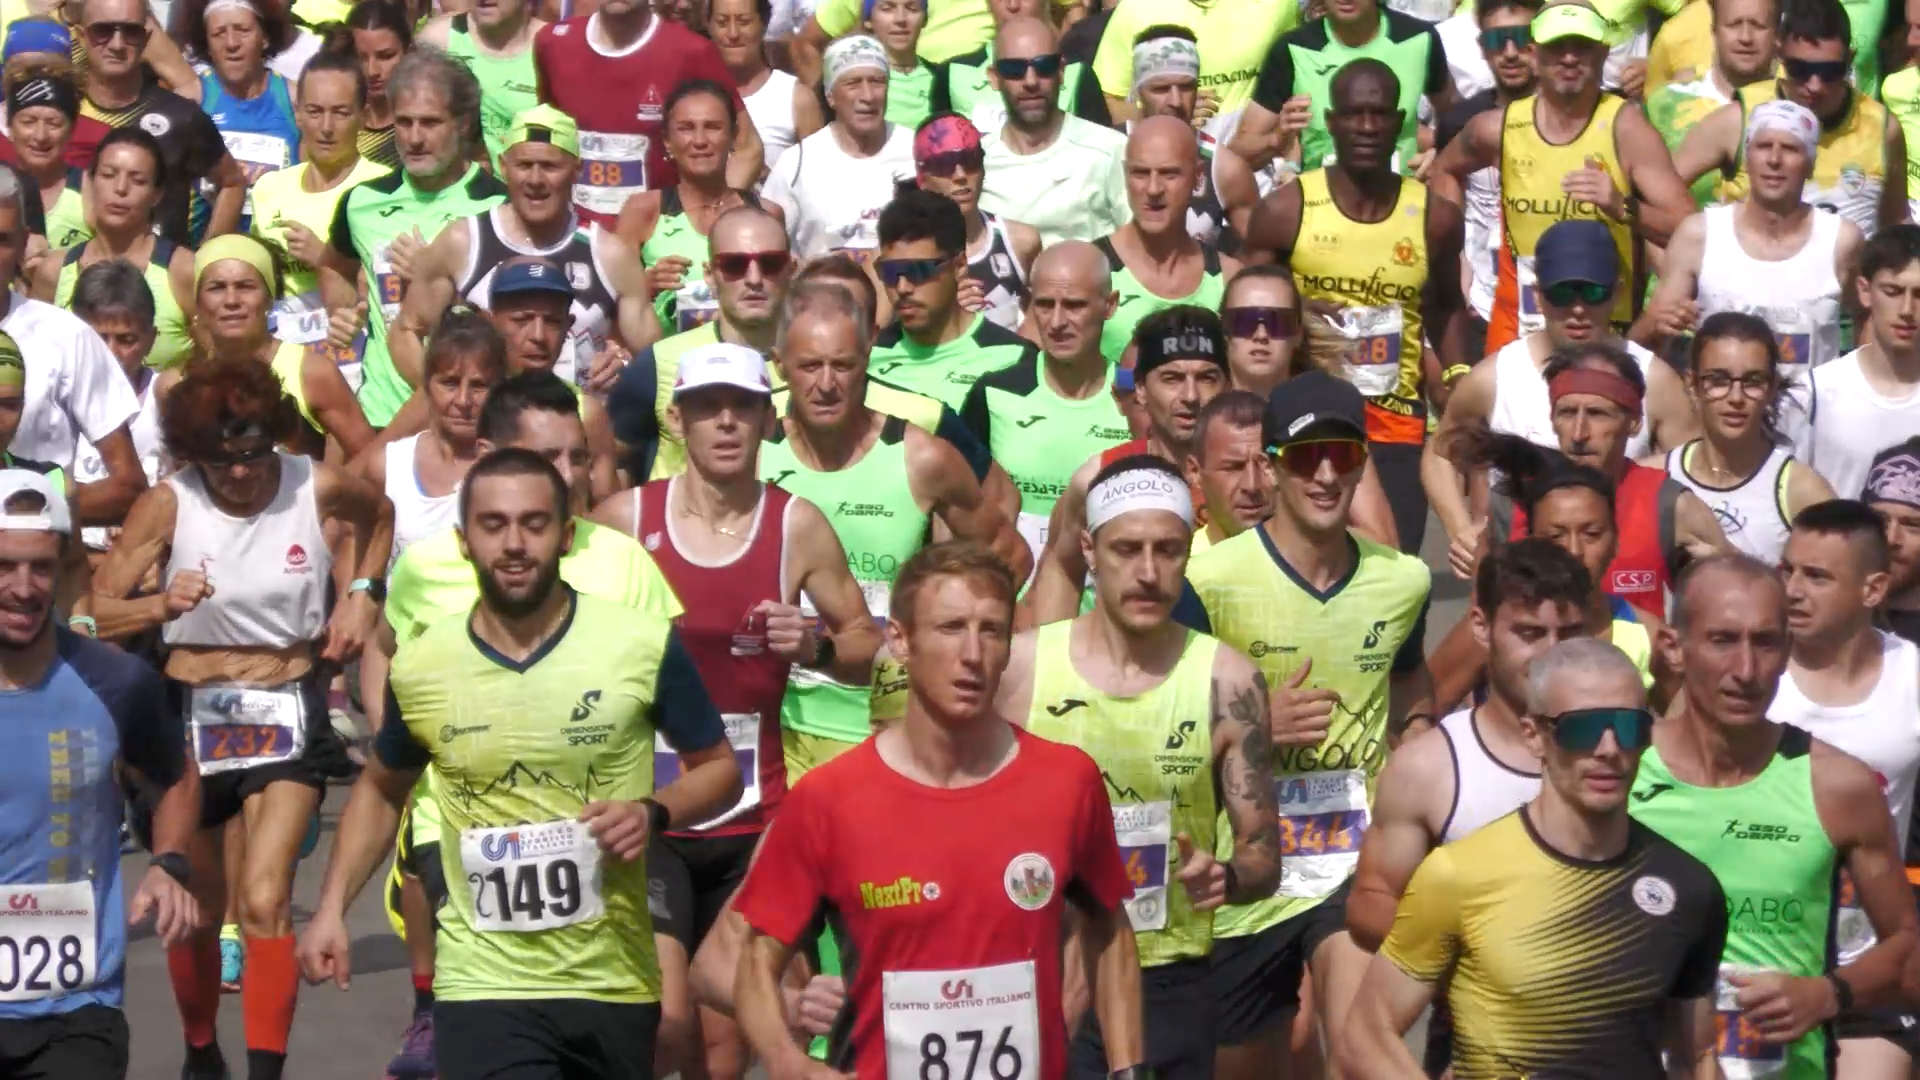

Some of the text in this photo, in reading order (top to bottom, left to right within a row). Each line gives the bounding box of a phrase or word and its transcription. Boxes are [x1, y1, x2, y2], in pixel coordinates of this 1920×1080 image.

[589, 162, 621, 186] 88
[1162, 336, 1213, 354] RUN
[1101, 479, 1174, 504] ANGOLO
[208, 727, 277, 758] 232
[567, 733, 609, 746] SPORT
[1161, 764, 1198, 776] SPORT
[1280, 816, 1352, 853] 344
[889, 991, 1032, 1011] CENTRO SPORTIVO ITALIANO
[919, 1025, 1023, 1080] 876
